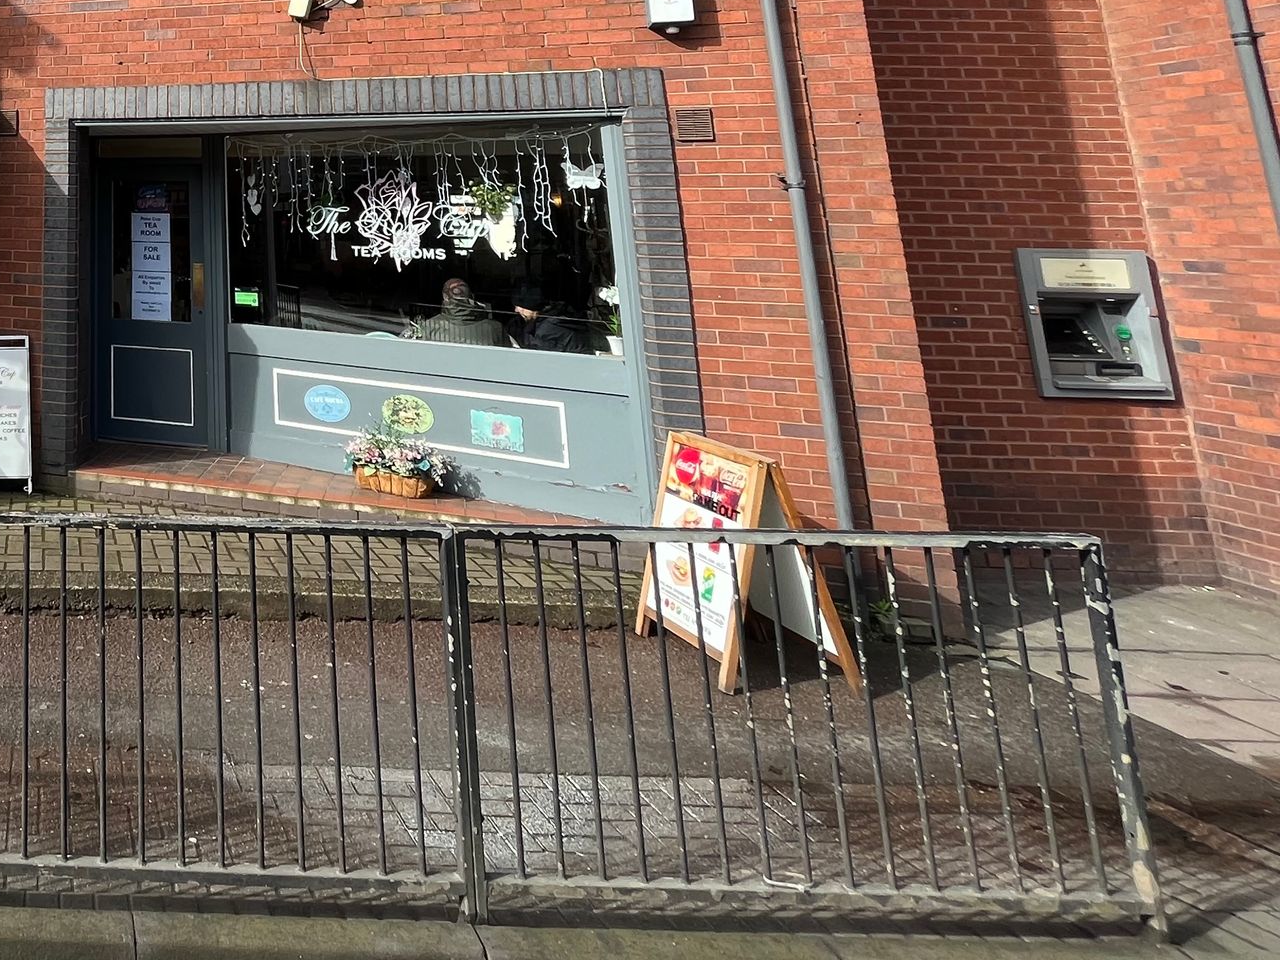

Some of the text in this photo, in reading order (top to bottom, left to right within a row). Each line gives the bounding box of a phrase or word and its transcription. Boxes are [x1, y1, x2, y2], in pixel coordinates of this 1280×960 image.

[307, 205, 351, 235] The
[351, 245, 446, 260] TEA ROOMS
[0, 367, 16, 379] Cup
